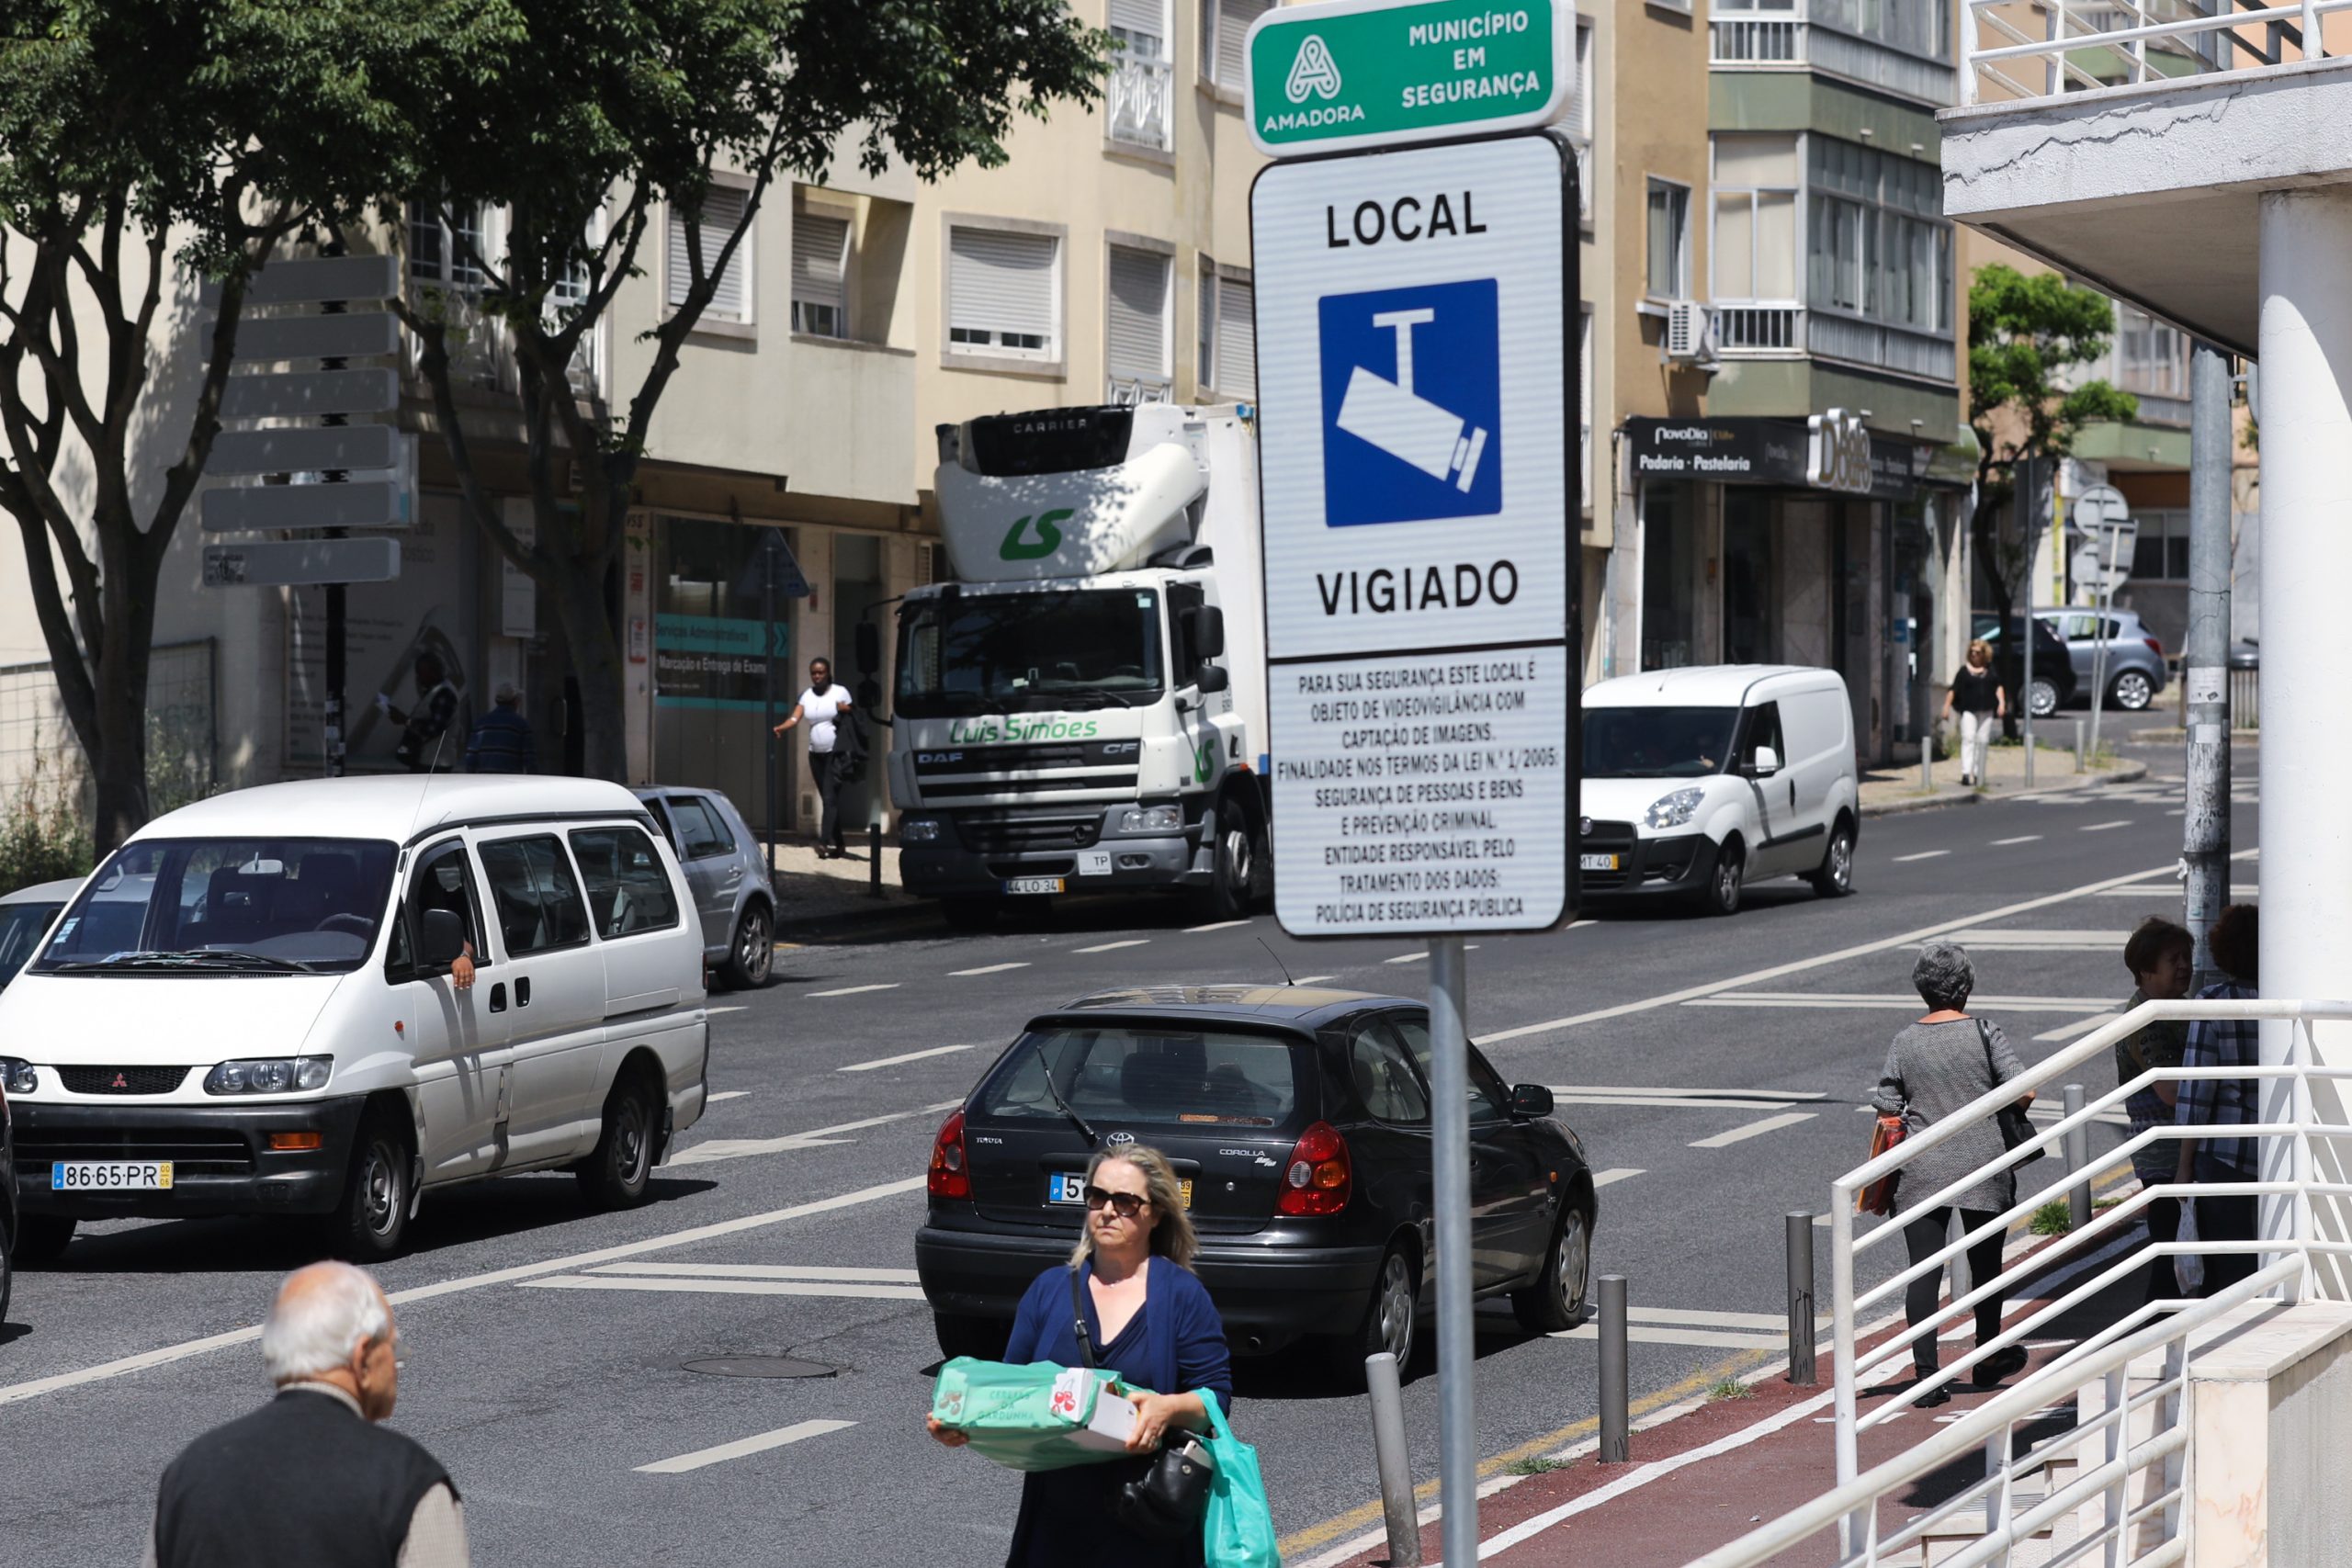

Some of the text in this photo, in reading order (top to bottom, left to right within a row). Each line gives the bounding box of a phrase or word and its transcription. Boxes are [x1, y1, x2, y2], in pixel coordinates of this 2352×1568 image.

[1408, 11, 1529, 46] MUNICÍPIO
[1453, 47, 1487, 71] EM
[1401, 71, 1540, 108] SEGURANÇA
[1263, 104, 1365, 133] AMADORA
[1327, 190, 1487, 248] LOCAL
[1013, 418, 1089, 434] CARRIER
[1640, 454, 1750, 471] Padaria Pastelaria
[1317, 559, 1518, 615] VIGIADO
[1298, 655, 1535, 694] PARA SUA SEGURANÇA ESTE LOCAL É
[1311, 691, 1525, 722] OBJETO DE VIDEOVIGILÂNCIA COM
[1004, 716, 1098, 741] Simões
[1342, 724, 1409, 753] CAPTAÇÃO
[1413, 726, 1430, 746] DE
[918, 742, 1137, 764] DAF CF
[1277, 758, 1352, 781] FINALIDADE
[1357, 756, 1382, 776] NOS
[1386, 753, 1439, 776] TERMOS
[1442, 752, 1459, 773] DA
[1464, 751, 1484, 772] LEI
[1315, 779, 1524, 811] SEGURANÇA DE PESSOAS E BENS
[1341, 817, 1350, 835] E
[1353, 809, 1429, 840] PREVENÇÃO
[1092, 855, 1109, 867] TP
[1325, 838, 1515, 866] ENTIDADE RESPONSÁVEL PELO
[1340, 872, 1421, 894] TRATAMENTO
[1425, 870, 1451, 891] DOS
[1317, 895, 1524, 924] POLÍCIA DE SEGURANÇA PÚBLICA
[1219, 1148, 1266, 1157] COROLLA
